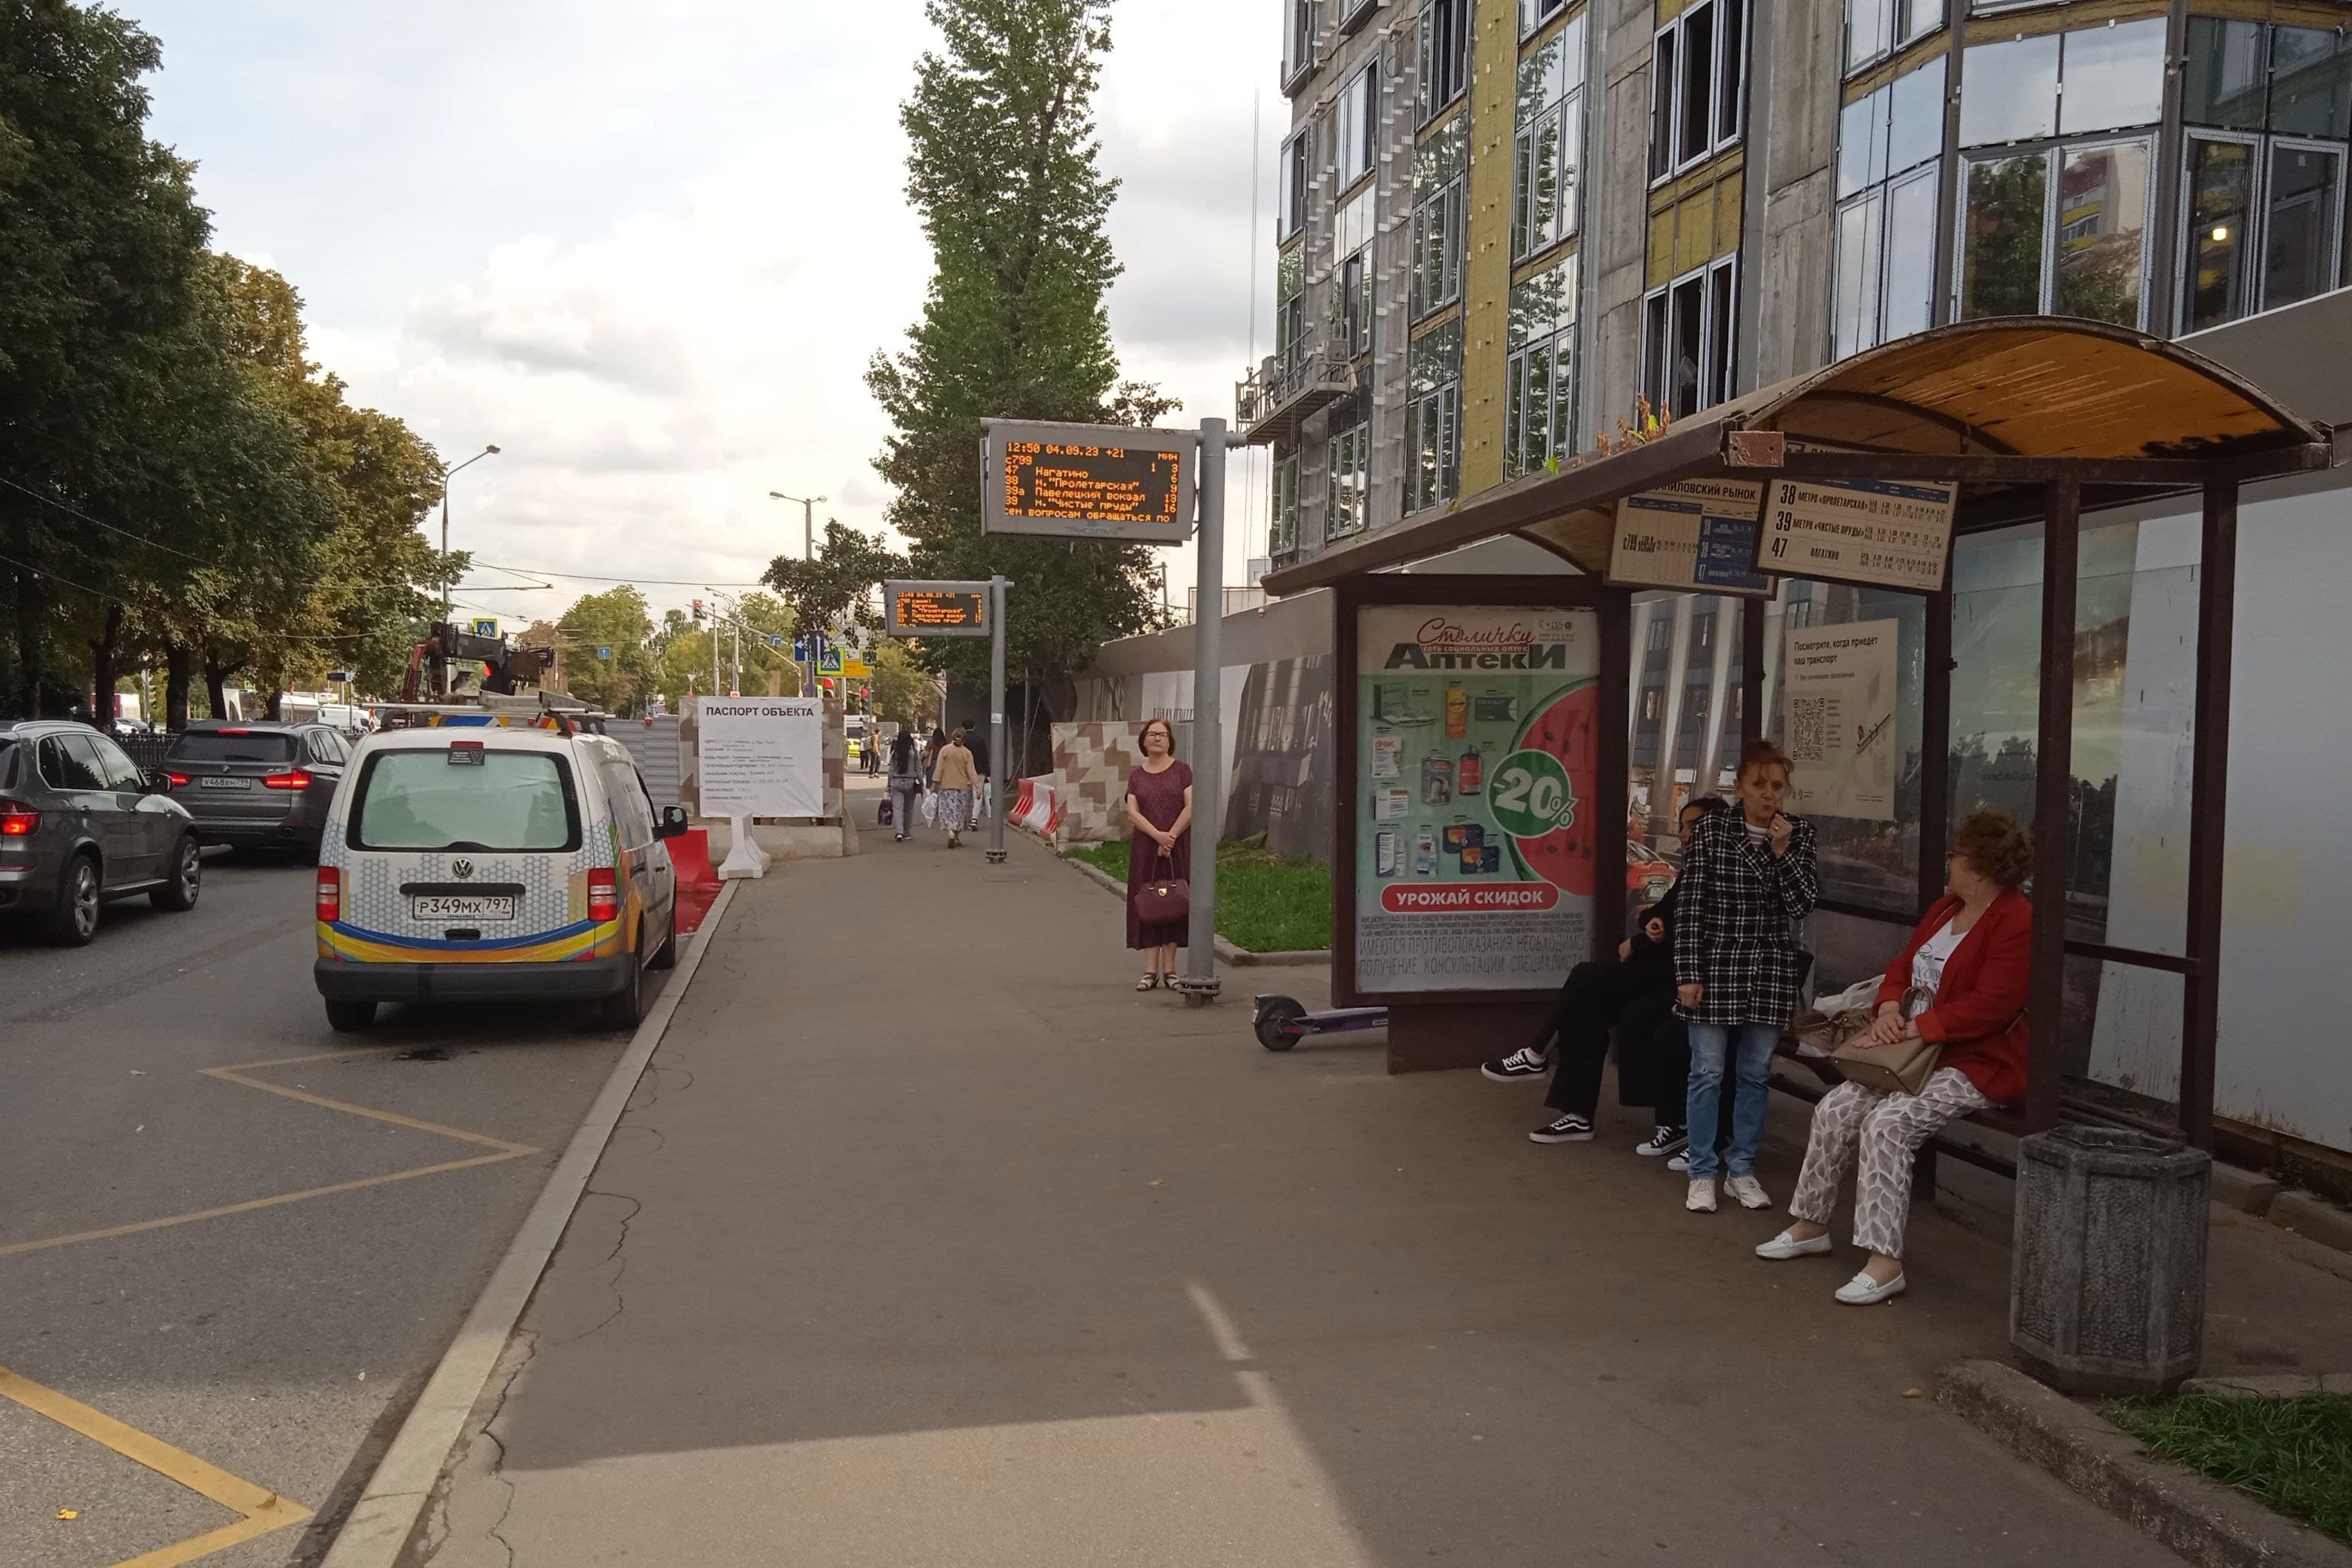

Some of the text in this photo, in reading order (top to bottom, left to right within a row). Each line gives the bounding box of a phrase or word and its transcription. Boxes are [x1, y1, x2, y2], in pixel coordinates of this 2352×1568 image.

[1008, 443, 1124, 458] 12:50 04.09.23 +21
[1158, 452, 1178, 461] мин
[1005, 465, 1178, 482] 47 Нагатино 6
[1005, 475, 1018, 485] 38
[1171, 484, 1178, 493] 9
[1035, 487, 1101, 499] Павелецкий
[1107, 492, 1145, 502] вокзал
[1723, 487, 1756, 500] РЫНОК
[1780, 484, 1796, 505] 38
[1798, 492, 1818, 503] МЕТРО
[1006, 496, 1018, 505] 39
[1165, 504, 1176, 513] 16
[1028, 509, 1080, 519] вопросам
[1086, 511, 1151, 522] обращаться
[1156, 514, 1170, 522] по
[1775, 511, 1793, 531] 39
[1793, 519, 1813, 529] МЕТРО
[1772, 537, 1788, 558] 47
[1810, 547, 1839, 560] НАГАТИНО
[1416, 617, 1536, 644] Столички
[1444, 645, 1499, 654] социальных
[1794, 637, 1878, 651] Посмотрите, когда приедет
[1806, 655, 1838, 666] транспорт
[706, 707, 814, 717] ПАСПОРТ ОБЪЕКТА
[485, 898, 509, 910] 797
[1396, 888, 1543, 906] УРОЖАЙ СКИДОК
[1359, 937, 1407, 955] ИМЕЮТСЯ
[1517, 933, 1583, 952] НЕОБХОДИМО
[1359, 954, 1582, 976] ПОЛУЧЕНИЕ КОНСУЛЬТАЦИИ СПЕЦИАЛИСТ
